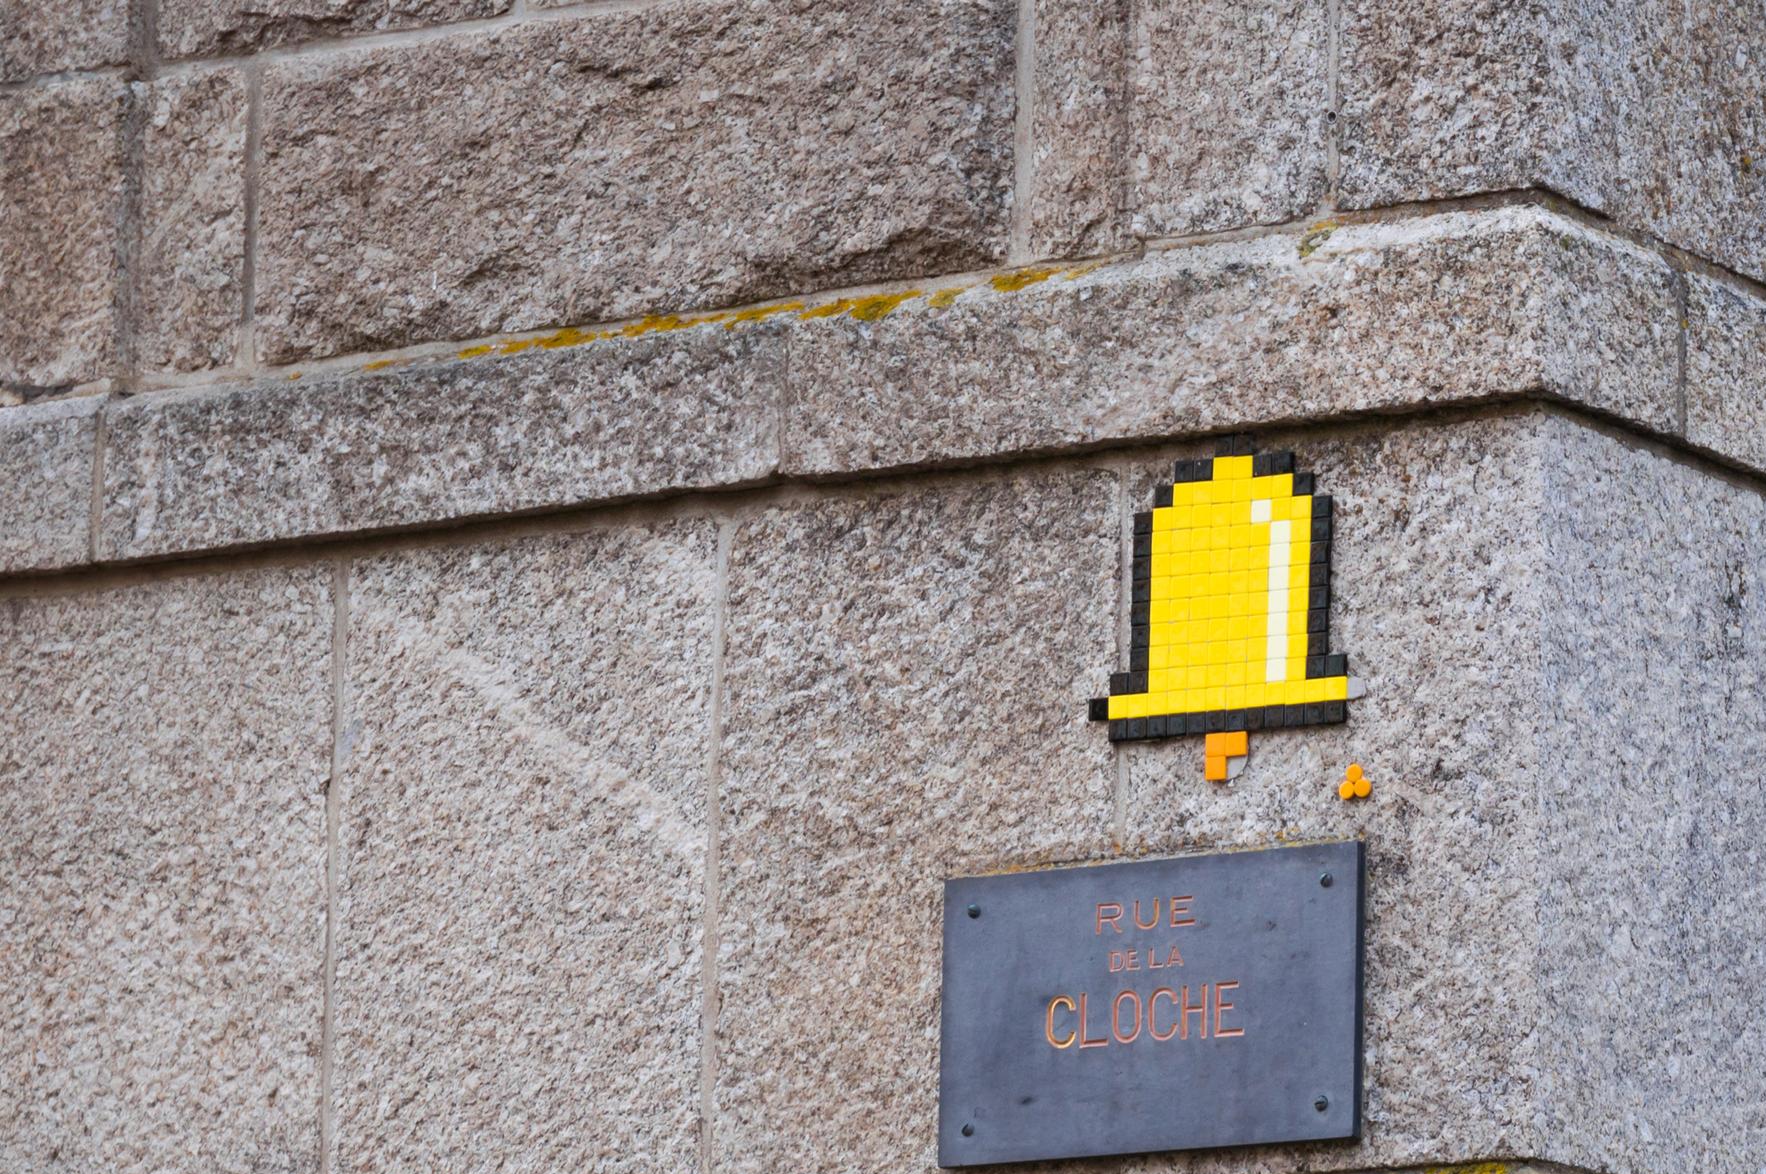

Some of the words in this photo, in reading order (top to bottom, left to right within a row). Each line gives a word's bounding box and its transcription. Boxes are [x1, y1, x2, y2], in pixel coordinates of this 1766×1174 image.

[1095, 895, 1195, 935] RUE
[1109, 949, 1140, 973] DE
[1149, 946, 1184, 968] LA
[1046, 981, 1244, 1049] CLOCHE
